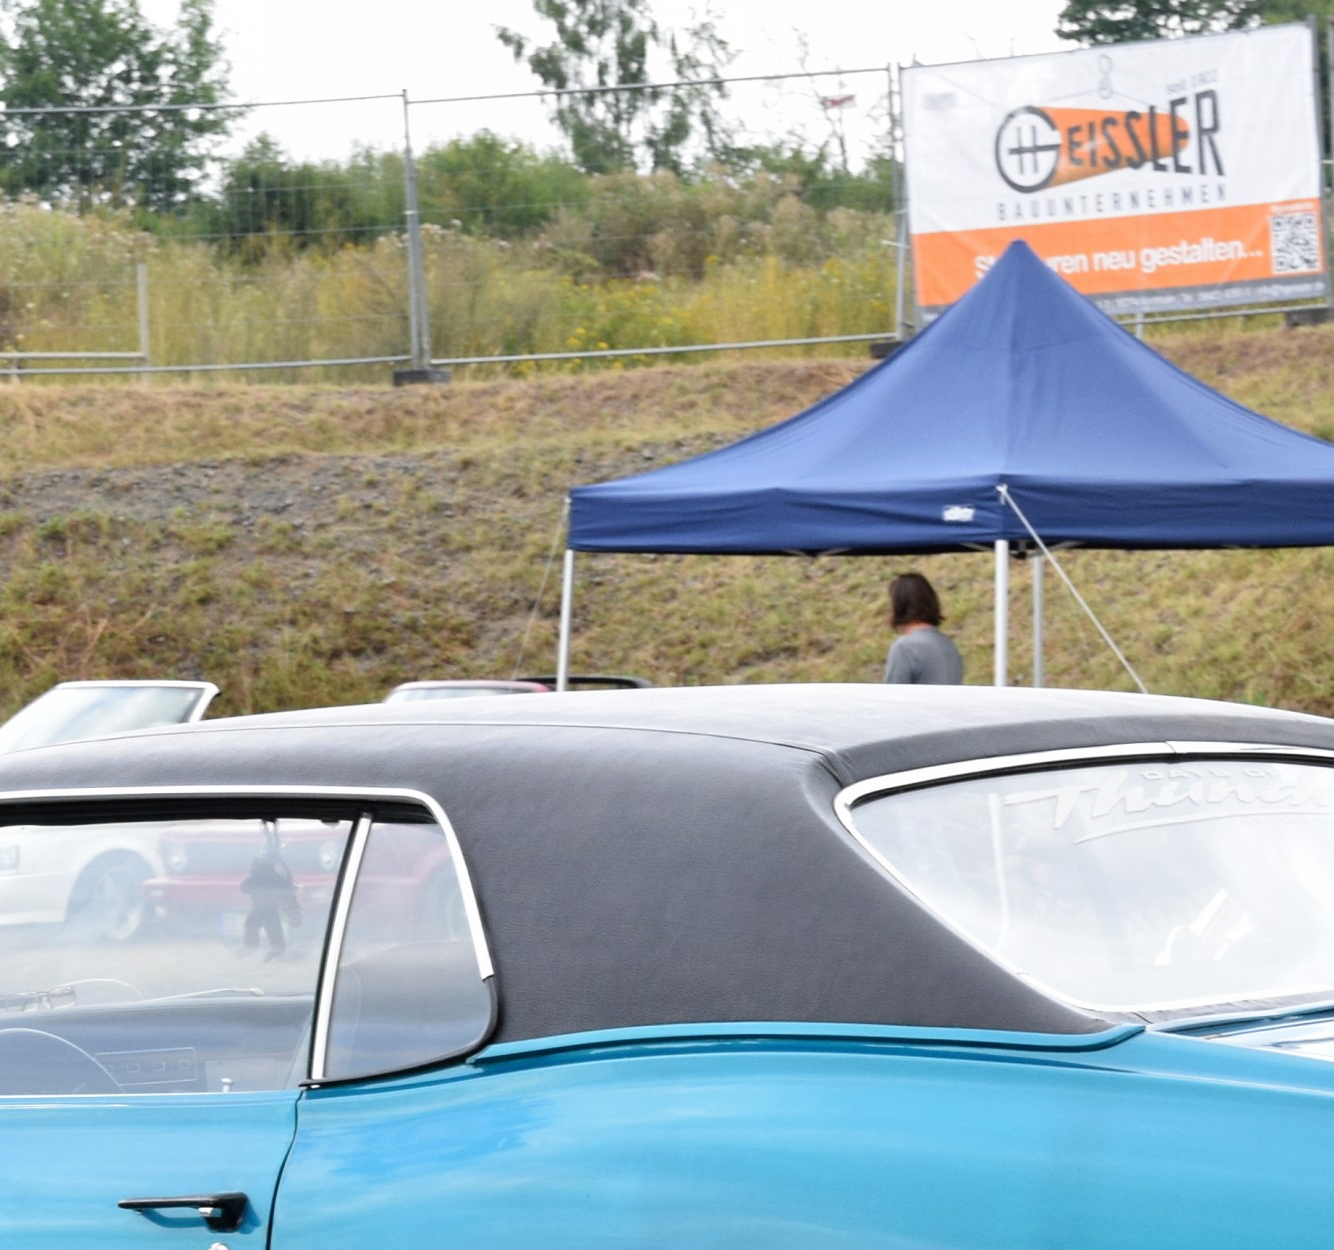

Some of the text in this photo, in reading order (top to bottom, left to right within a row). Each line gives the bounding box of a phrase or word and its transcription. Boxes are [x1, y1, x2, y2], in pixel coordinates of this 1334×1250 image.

[994, 88, 1225, 194] GEISSLER
[997, 183, 1227, 222] BAUUNTERNEHMEN
[1093, 249, 1136, 273] neu
[1139, 237, 1264, 275] gestalten...
